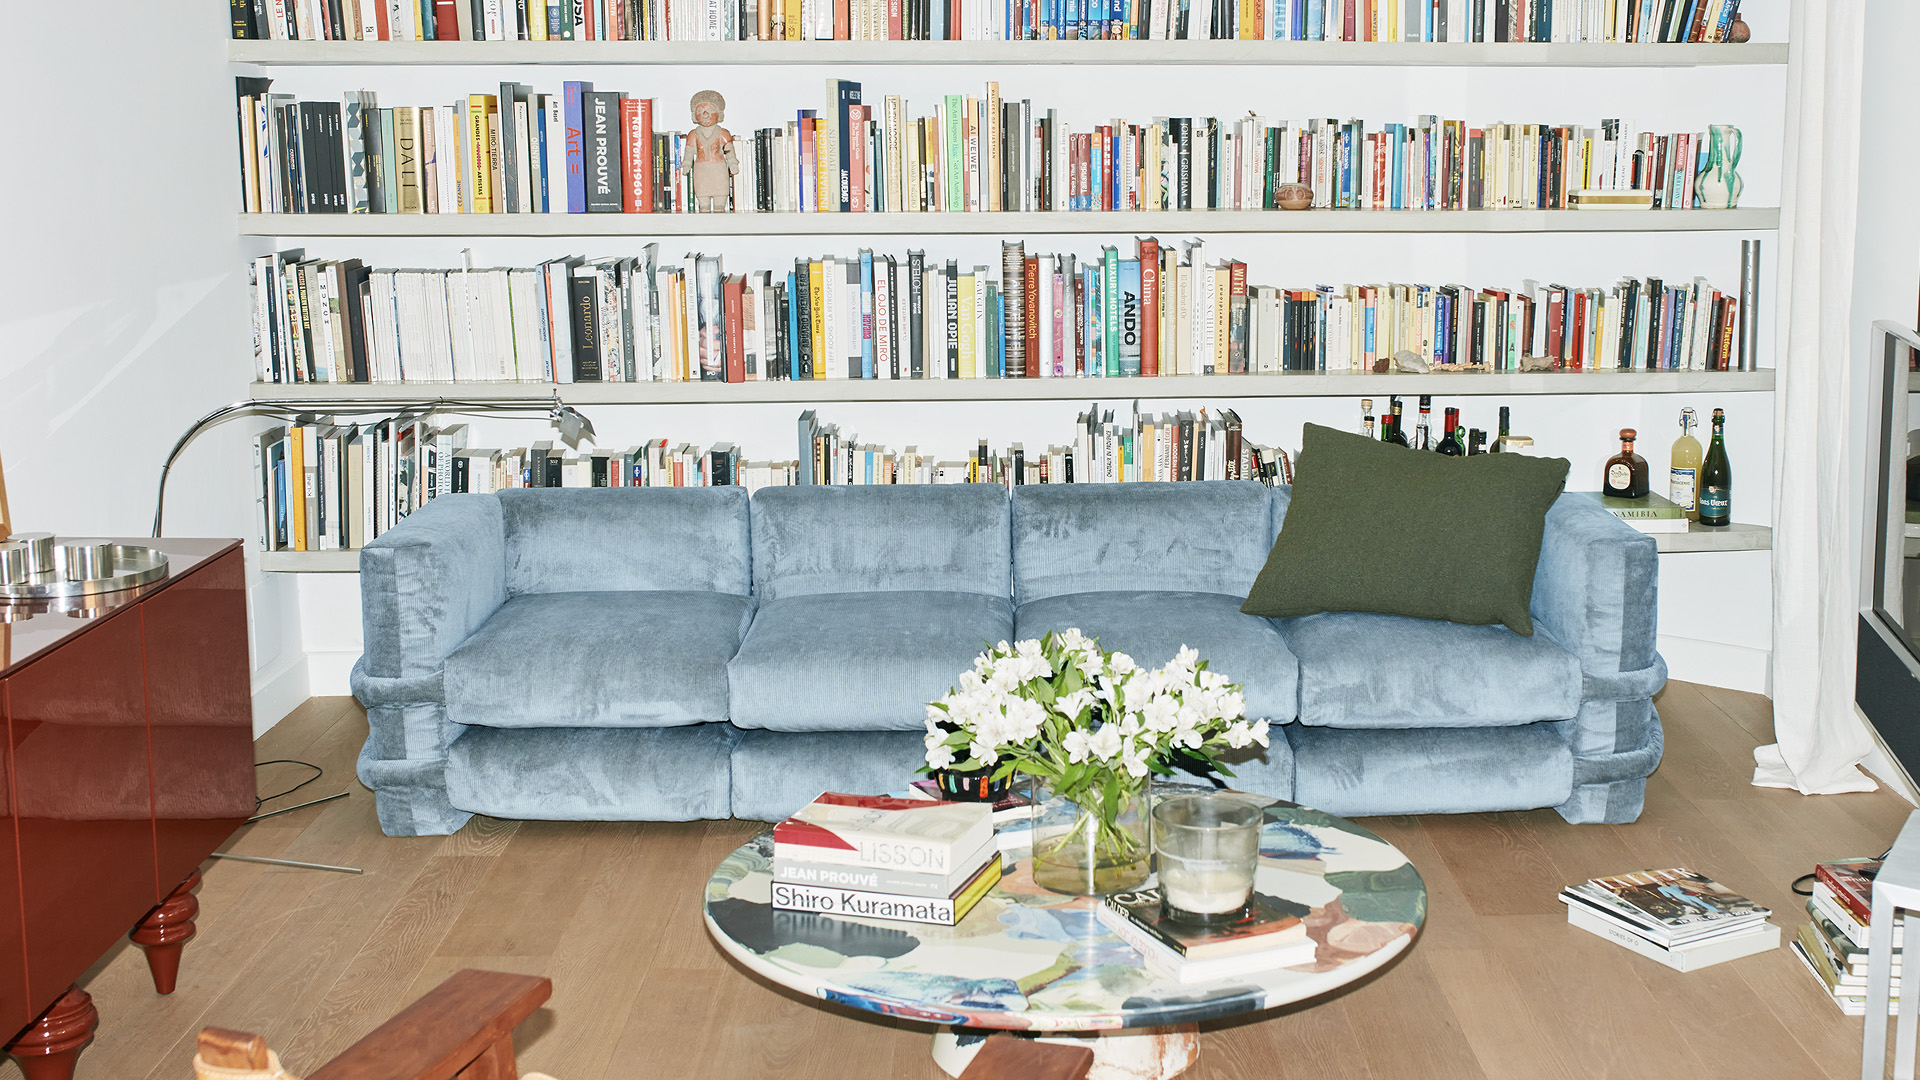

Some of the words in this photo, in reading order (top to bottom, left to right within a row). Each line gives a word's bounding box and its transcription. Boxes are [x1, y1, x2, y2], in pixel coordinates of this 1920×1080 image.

[594, 97, 606, 134] JEAN
[632, 116, 640, 138] New
[970, 125, 976, 134] AI
[566, 126, 581, 157] Art
[1180, 122, 1188, 146] JOHN
[400, 137, 419, 189] DALÍ
[632, 141, 642, 165] York
[818, 130, 828, 168] DESIGN
[829, 140, 837, 172] LIVING
[596, 138, 611, 195] PROUVÉ
[1181, 158, 1189, 196] GRISHAM
[633, 168, 642, 196] 1960
[820, 171, 828, 208] INDIAN
[840, 169, 849, 203] JACQUEMUS
[878, 279, 885, 292] EL
[912, 259, 921, 294] HOTELS
[1028, 263, 1036, 288] Pierre
[1143, 268, 1155, 305] China
[1233, 268, 1244, 294] WITH
[947, 276, 957, 319] JULIAN
[961, 296, 972, 320] Van
[580, 296, 594, 350] Leonardo
[862, 314, 872, 340] Havana
[879, 318, 886, 332] DE
[1028, 288, 1037, 338] Yovanovitch
[1124, 290, 1136, 345] ANDO
[1206, 304, 1214, 348] SCHIELE
[880, 335, 889, 362] MIRÓ
[948, 322, 958, 349] OPIE
[958, 323, 974, 359] Gogh
[1722, 327, 1732, 358] Platform
[1218, 350, 1222, 359] La
[438, 452, 444, 462] OF
[859, 841, 944, 869] LISSON
[780, 866, 818, 882] JEAN
[820, 868, 878, 888] PROUVÉ
[775, 886, 835, 911] Shiro
[840, 893, 950, 922] Kuramata
[1106, 898, 1130, 920] CALDER
[1608, 929, 1626, 942] STORIES
